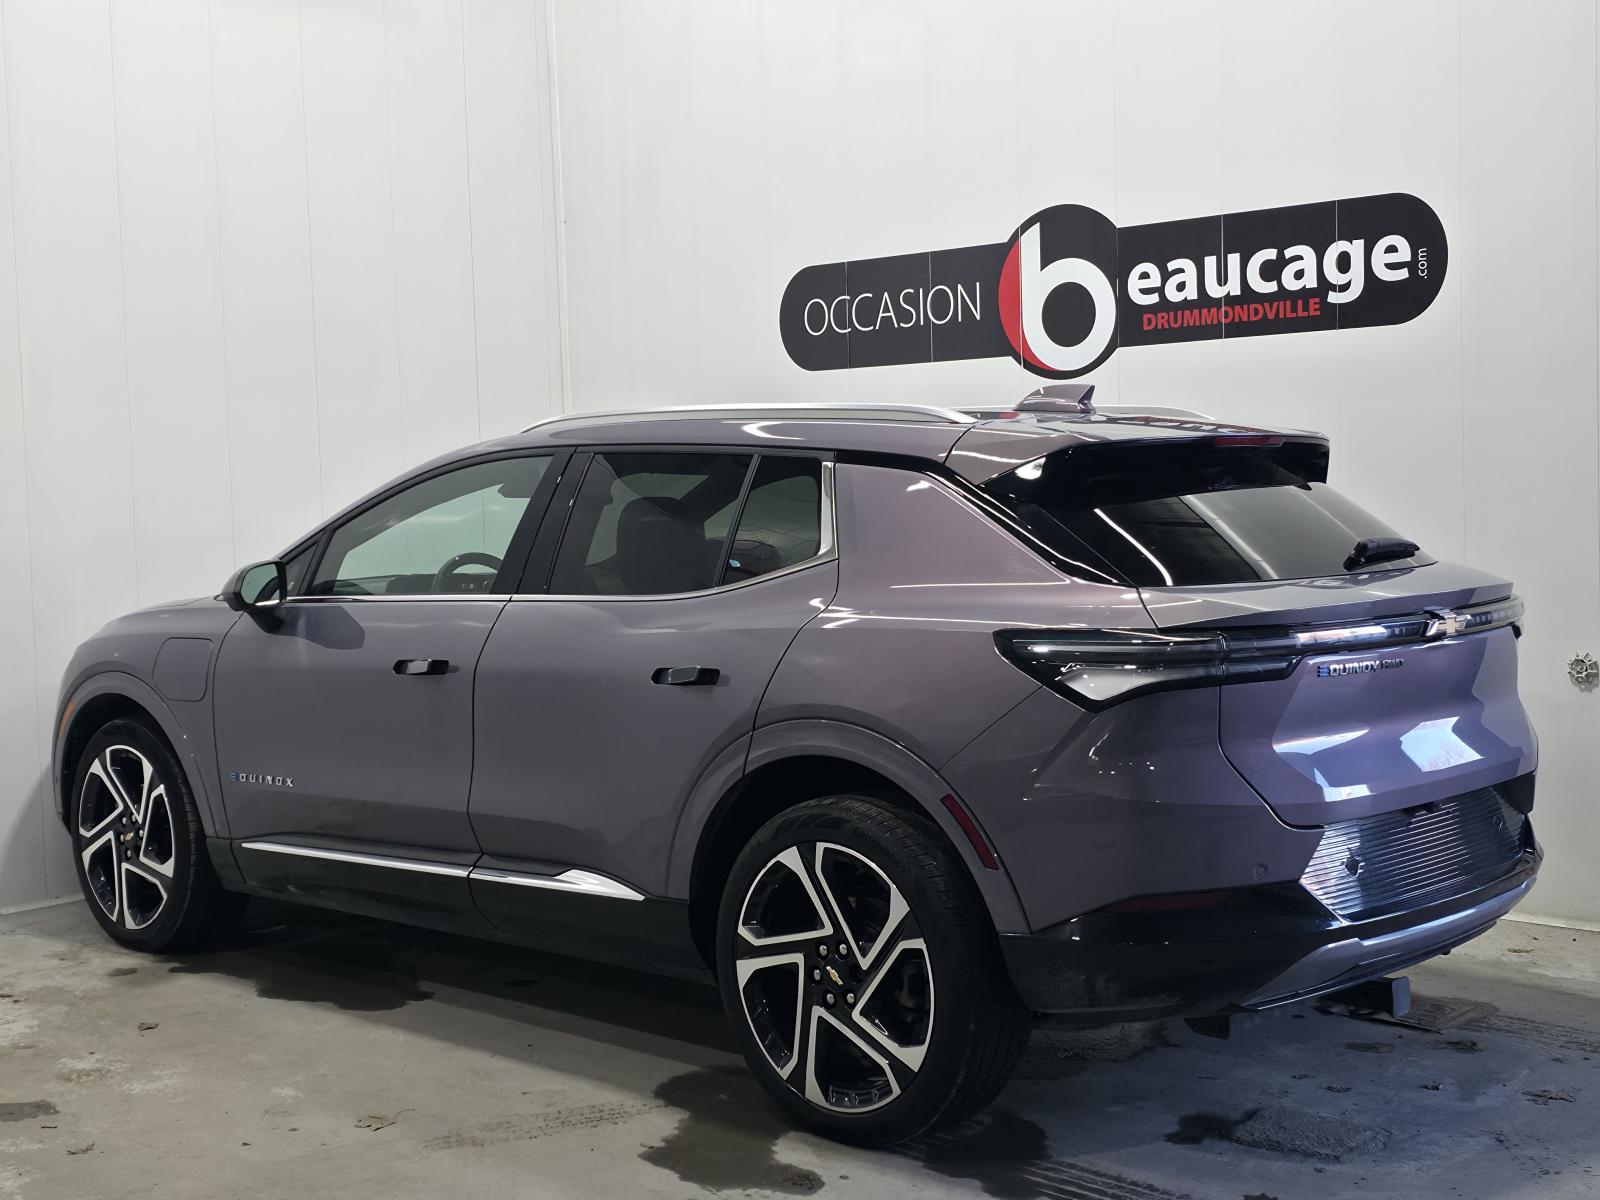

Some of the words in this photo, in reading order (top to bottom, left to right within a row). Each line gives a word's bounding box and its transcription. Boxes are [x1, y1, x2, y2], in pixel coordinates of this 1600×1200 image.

[804, 281, 981, 336] OCCASION
[1143, 297, 1321, 331] DRUMMONDVILLE
[1317, 660, 1380, 678] EQUINOX
[229, 771, 294, 788] EQUINOX
